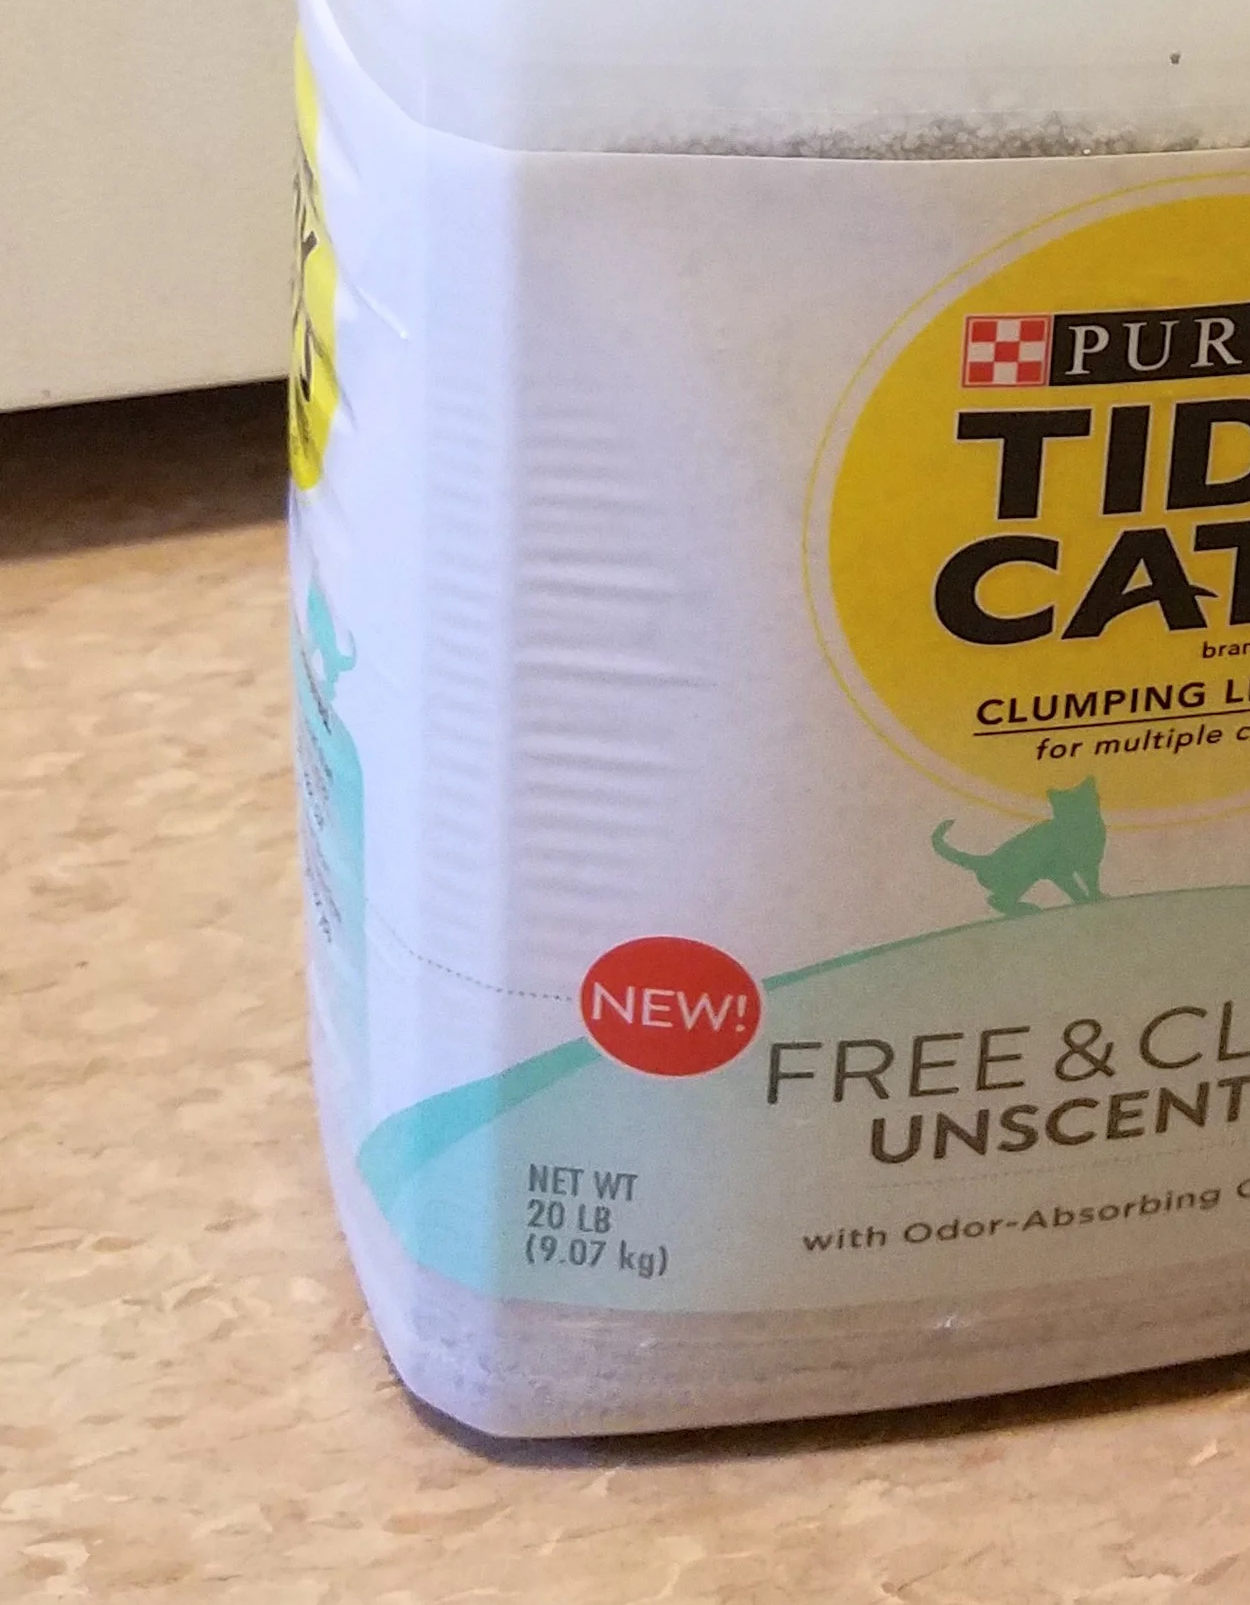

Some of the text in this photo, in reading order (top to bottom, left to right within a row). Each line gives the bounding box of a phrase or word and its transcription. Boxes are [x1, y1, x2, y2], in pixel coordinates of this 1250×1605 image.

[975, 681, 1206, 726] CLUMPING
[1035, 736, 1083, 761] for
[1094, 725, 1223, 757] multiple
[590, 980, 748, 1034] NEW!
[766, 1025, 1031, 1105] FREE
[1054, 1017, 1117, 1082] &
[528, 1164, 638, 1202] NET WT
[526, 1199, 611, 1233] 20 LB
[803, 1225, 886, 1253] with
[903, 1186, 1221, 1244] Odor-Absorbing
[524, 1235, 669, 1279] (9.07 kg)
